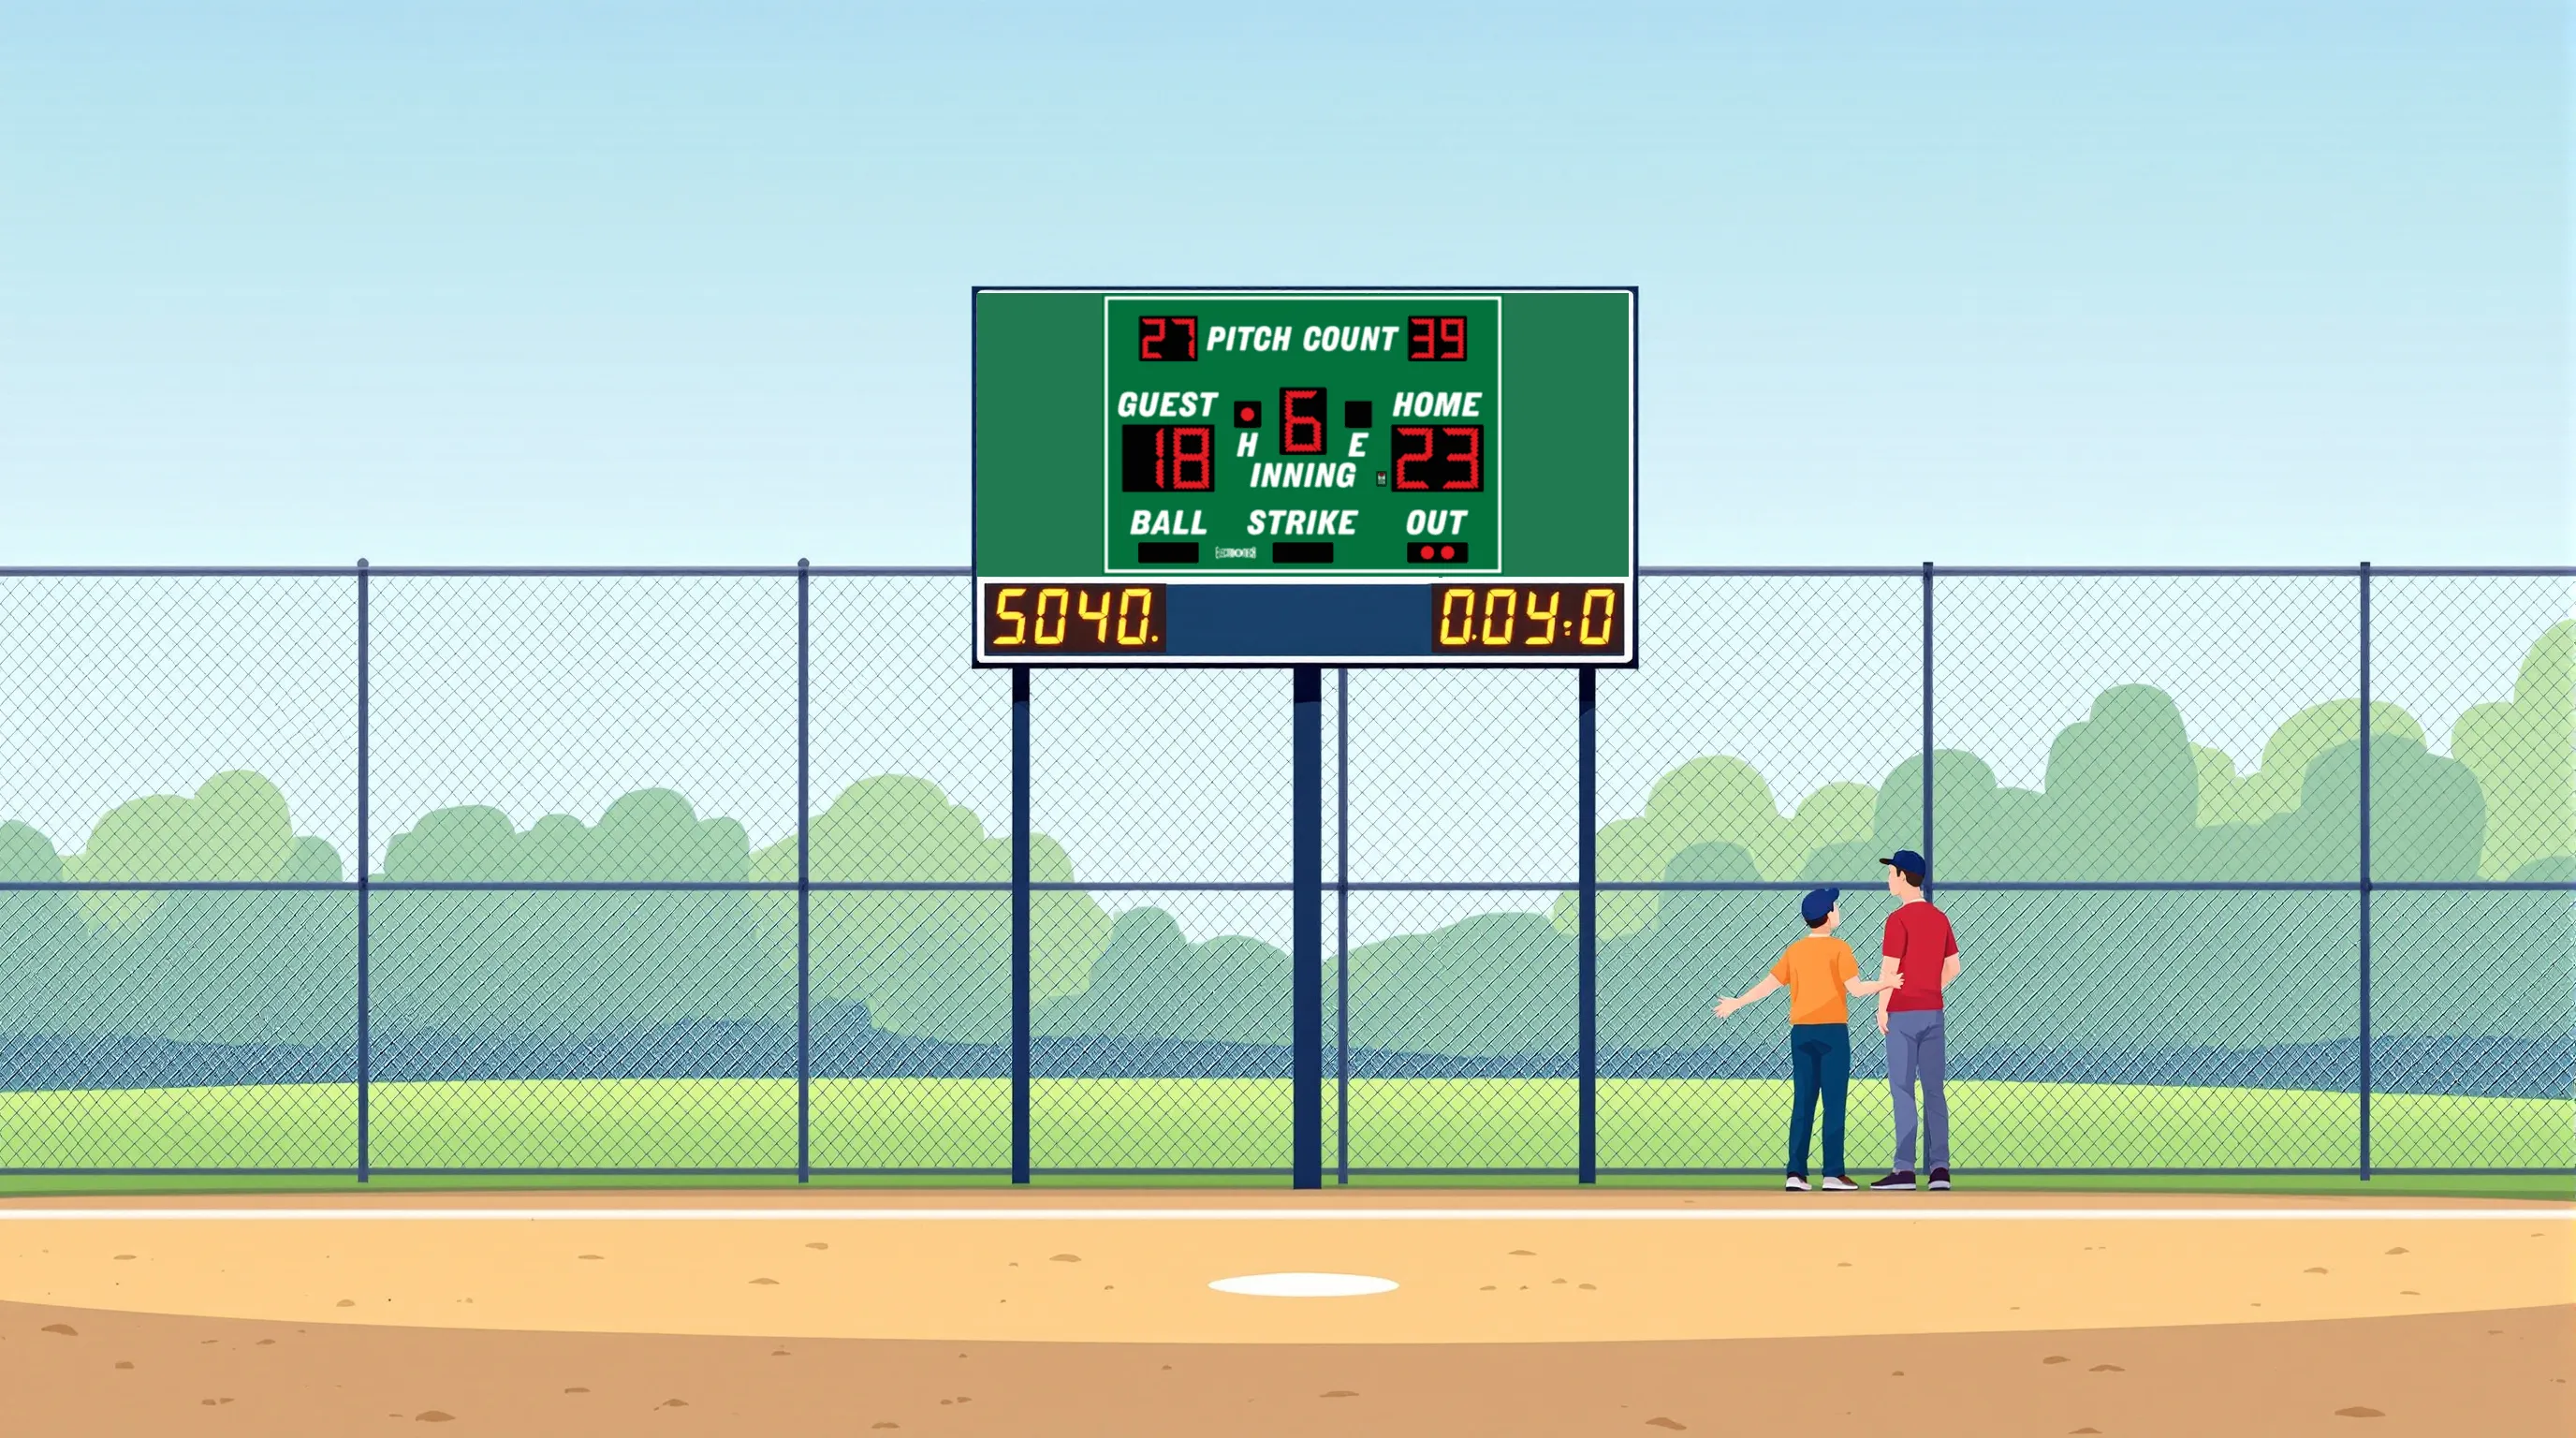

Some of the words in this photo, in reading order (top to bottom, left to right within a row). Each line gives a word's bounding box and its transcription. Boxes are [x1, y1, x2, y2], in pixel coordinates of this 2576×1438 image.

[1143, 318, 1194, 359] 27
[1208, 326, 1292, 351] PITCH
[1303, 326, 1399, 351] COUNT
[1412, 318, 1464, 359] 39
[1119, 392, 1219, 417] GUEST
[1393, 392, 1482, 417] HOME
[1285, 391, 1321, 451] 6
[1237, 433, 1258, 457] H
[1349, 433, 1368, 457] E
[1156, 428, 1209, 489] 18
[1397, 428, 1478, 489] 23
[1251, 462, 1355, 488] INNING
[1131, 510, 1207, 535] BALL
[1248, 510, 1358, 535] STRIKE
[1407, 509, 1468, 535] OUT
